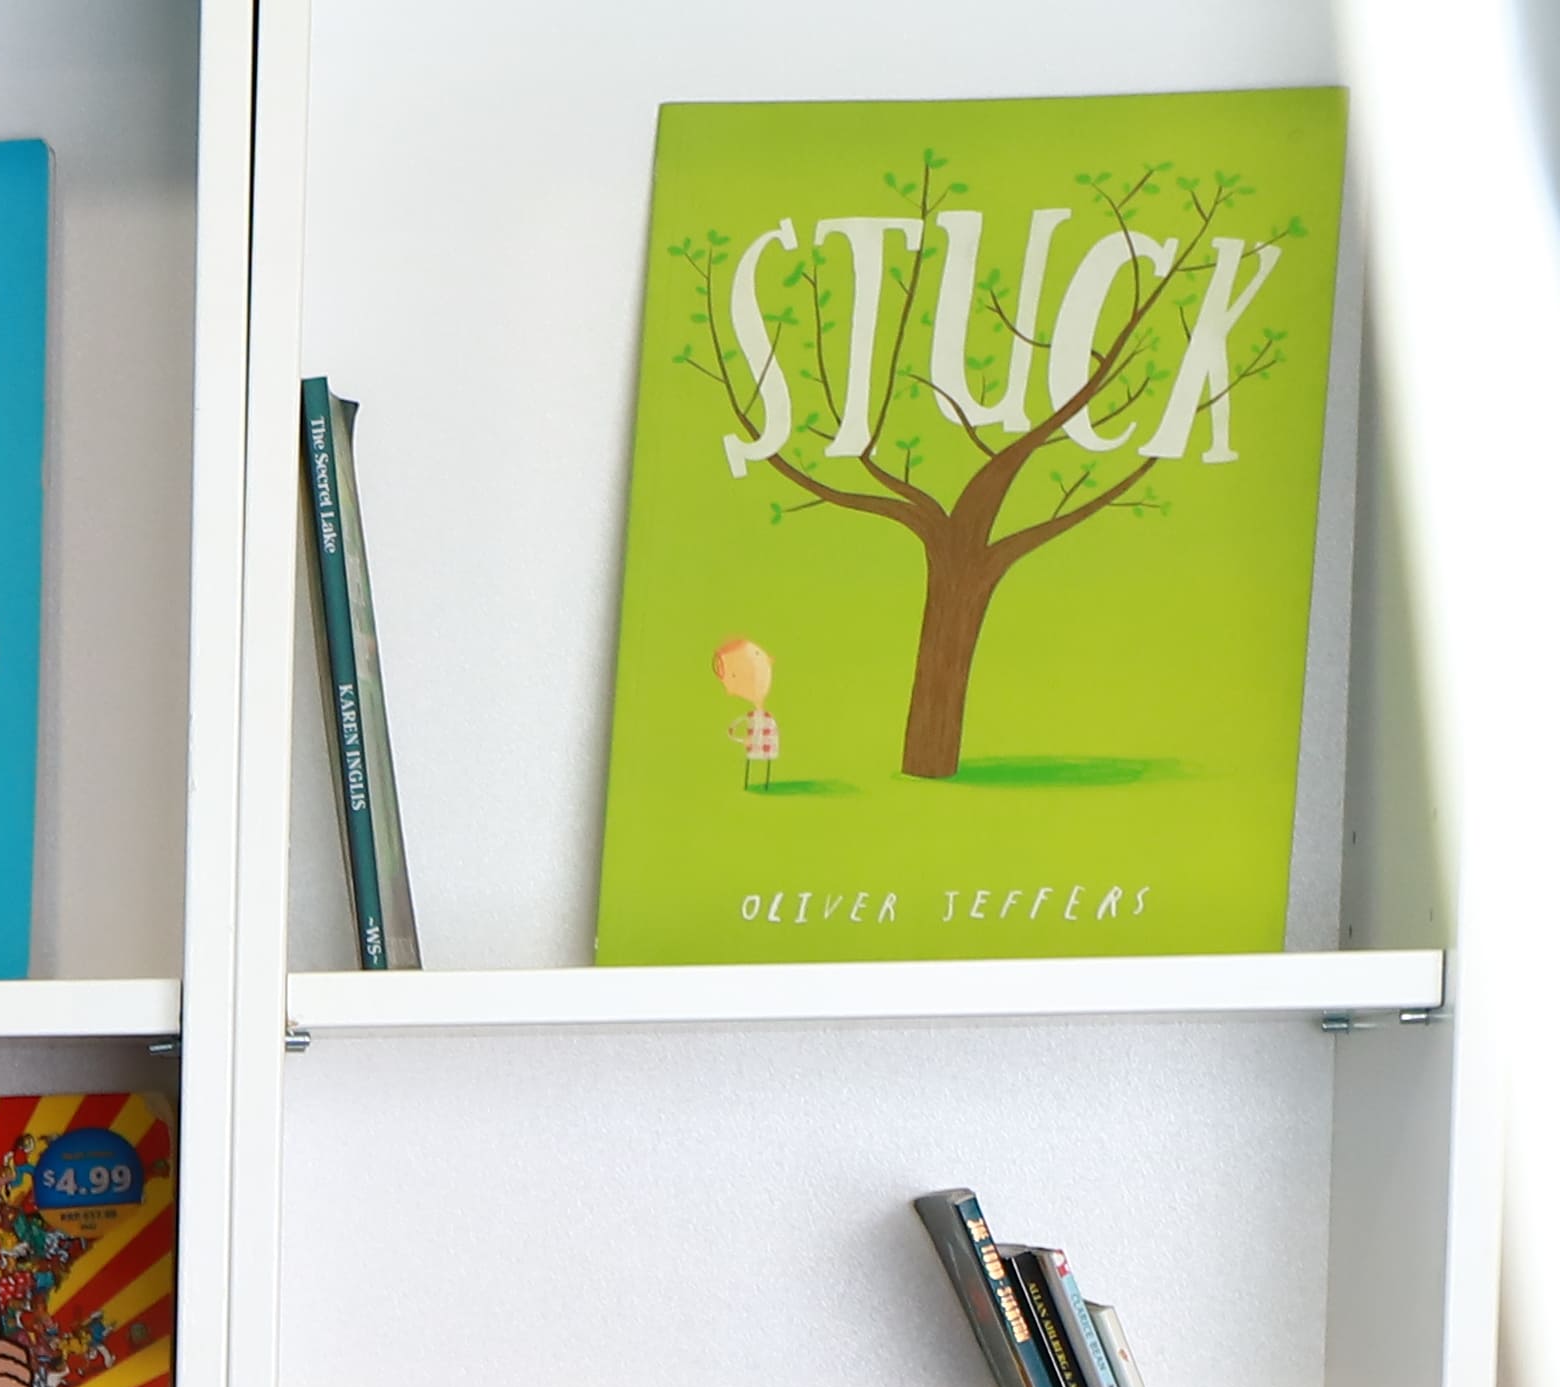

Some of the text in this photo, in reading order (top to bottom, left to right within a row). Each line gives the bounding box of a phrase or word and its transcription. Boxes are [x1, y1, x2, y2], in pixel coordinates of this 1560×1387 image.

[723, 208, 1283, 479] STUCK
[311, 417, 336, 554] The Secret Lake
[339, 684, 366, 811] KAREN INGLIS
[741, 885, 1150, 924] OLIVER JEFFERS
[42, 1165, 132, 1196] $4.99
